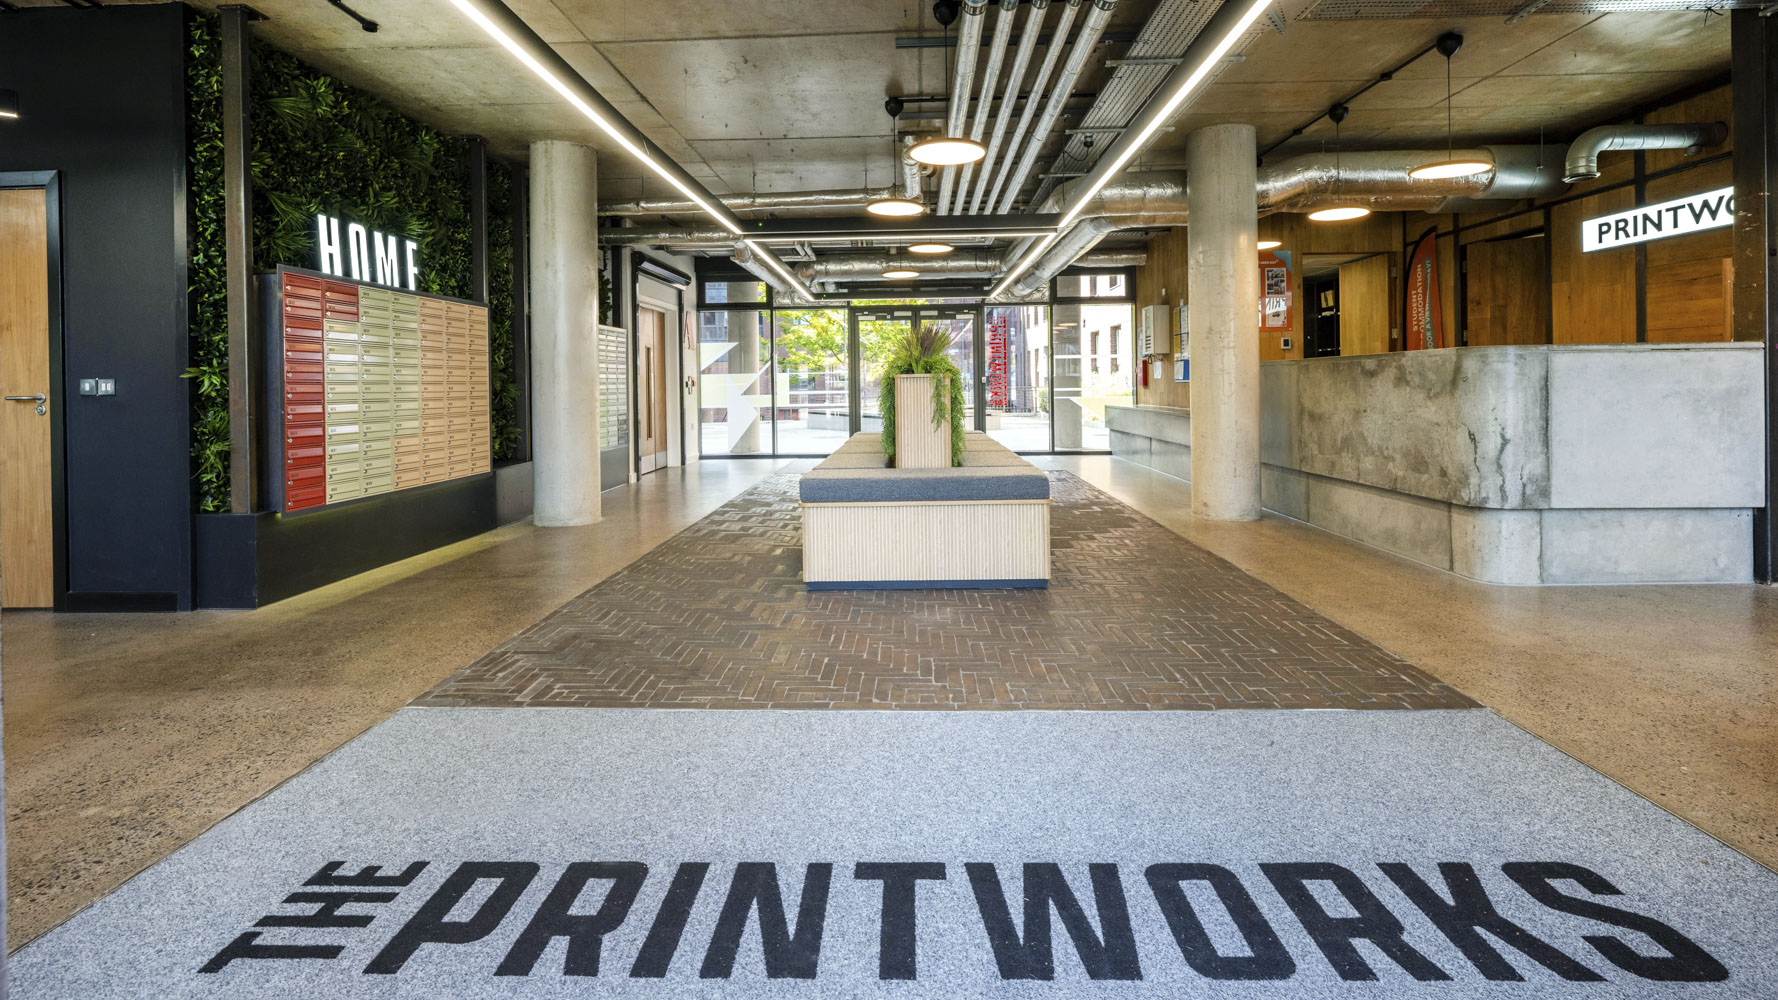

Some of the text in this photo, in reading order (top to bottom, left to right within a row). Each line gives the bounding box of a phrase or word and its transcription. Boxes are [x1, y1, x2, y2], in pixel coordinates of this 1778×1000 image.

[318, 213, 419, 291] HOME
[1417, 264, 1425, 349] OMMODATION
[197, 861, 1729, 981] THE PRINTWORKS
